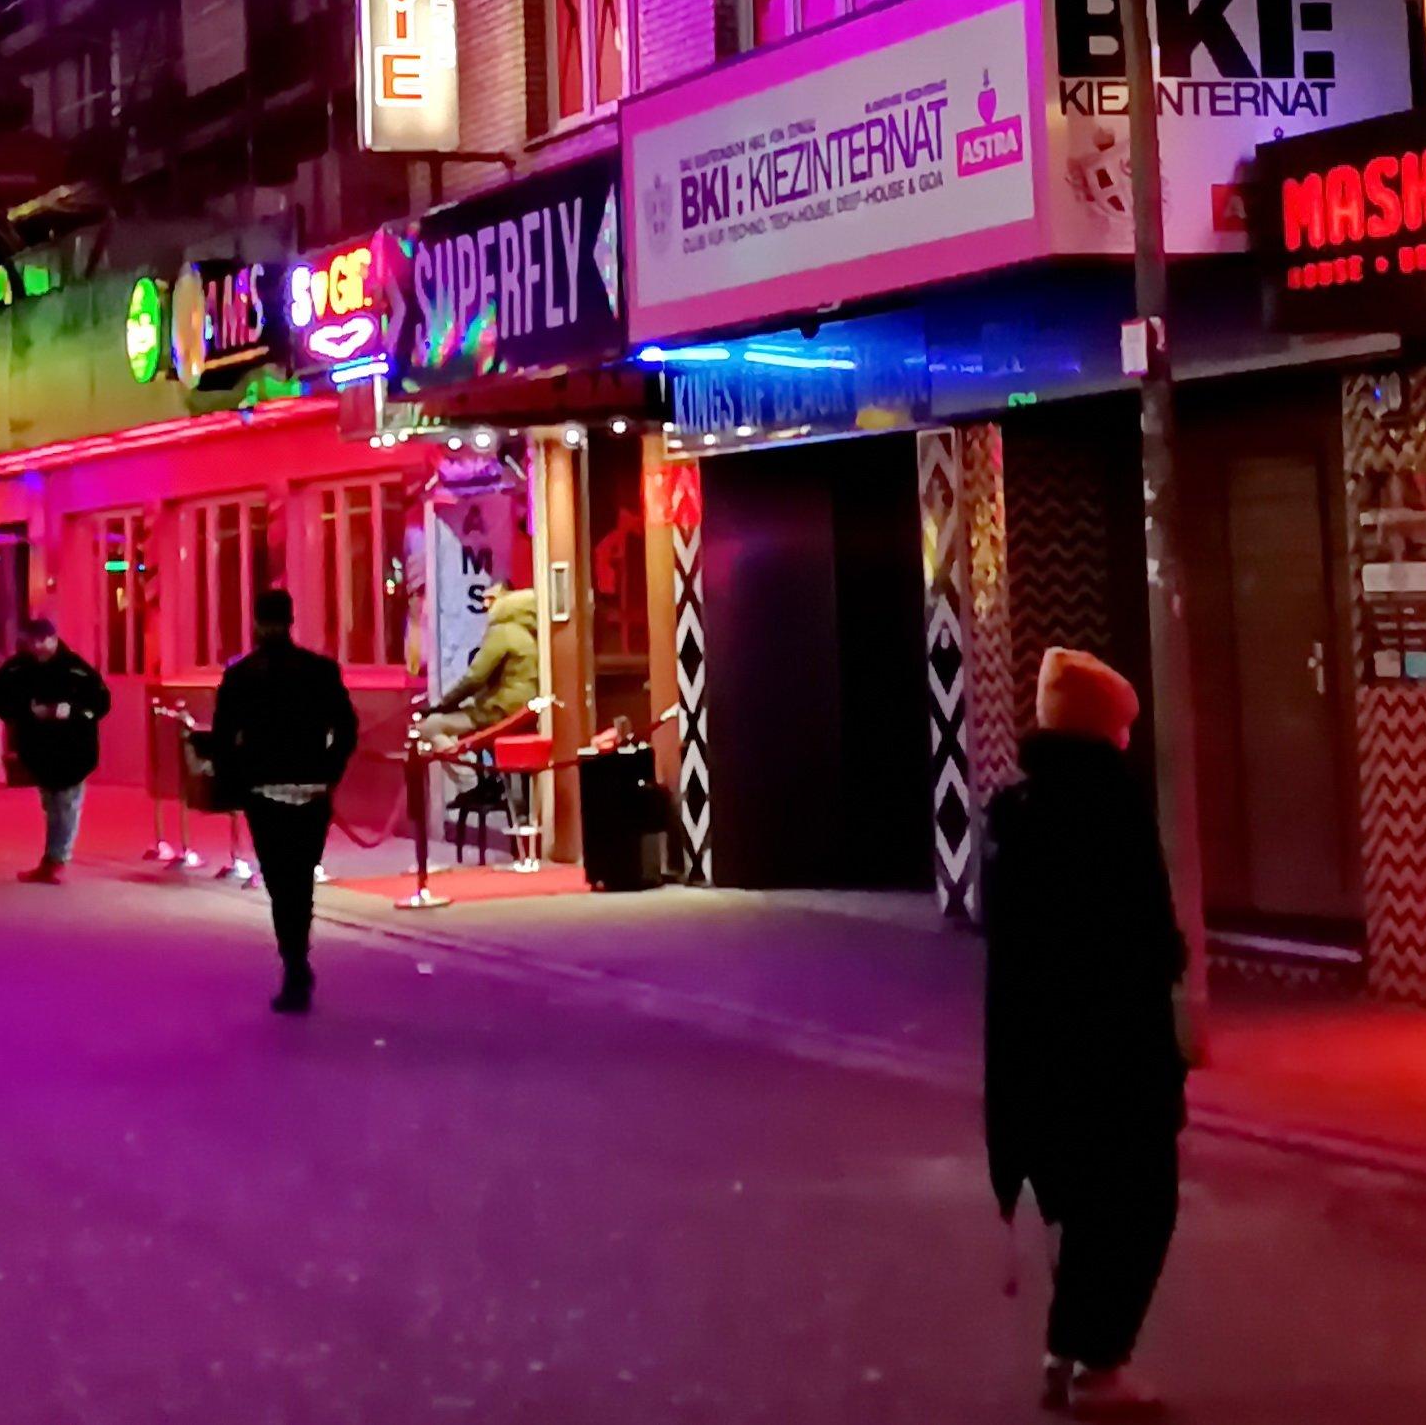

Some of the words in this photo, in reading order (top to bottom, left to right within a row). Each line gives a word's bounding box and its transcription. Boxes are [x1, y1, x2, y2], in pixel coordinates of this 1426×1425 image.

[1058, 80, 1336, 117] KIENTERNAT
[748, 97, 949, 212] KIEZINTERNAT
[961, 128, 1018, 166] ASTRA
[411, 196, 583, 365] SUPERFLY
[674, 374, 735, 435] KINGS
